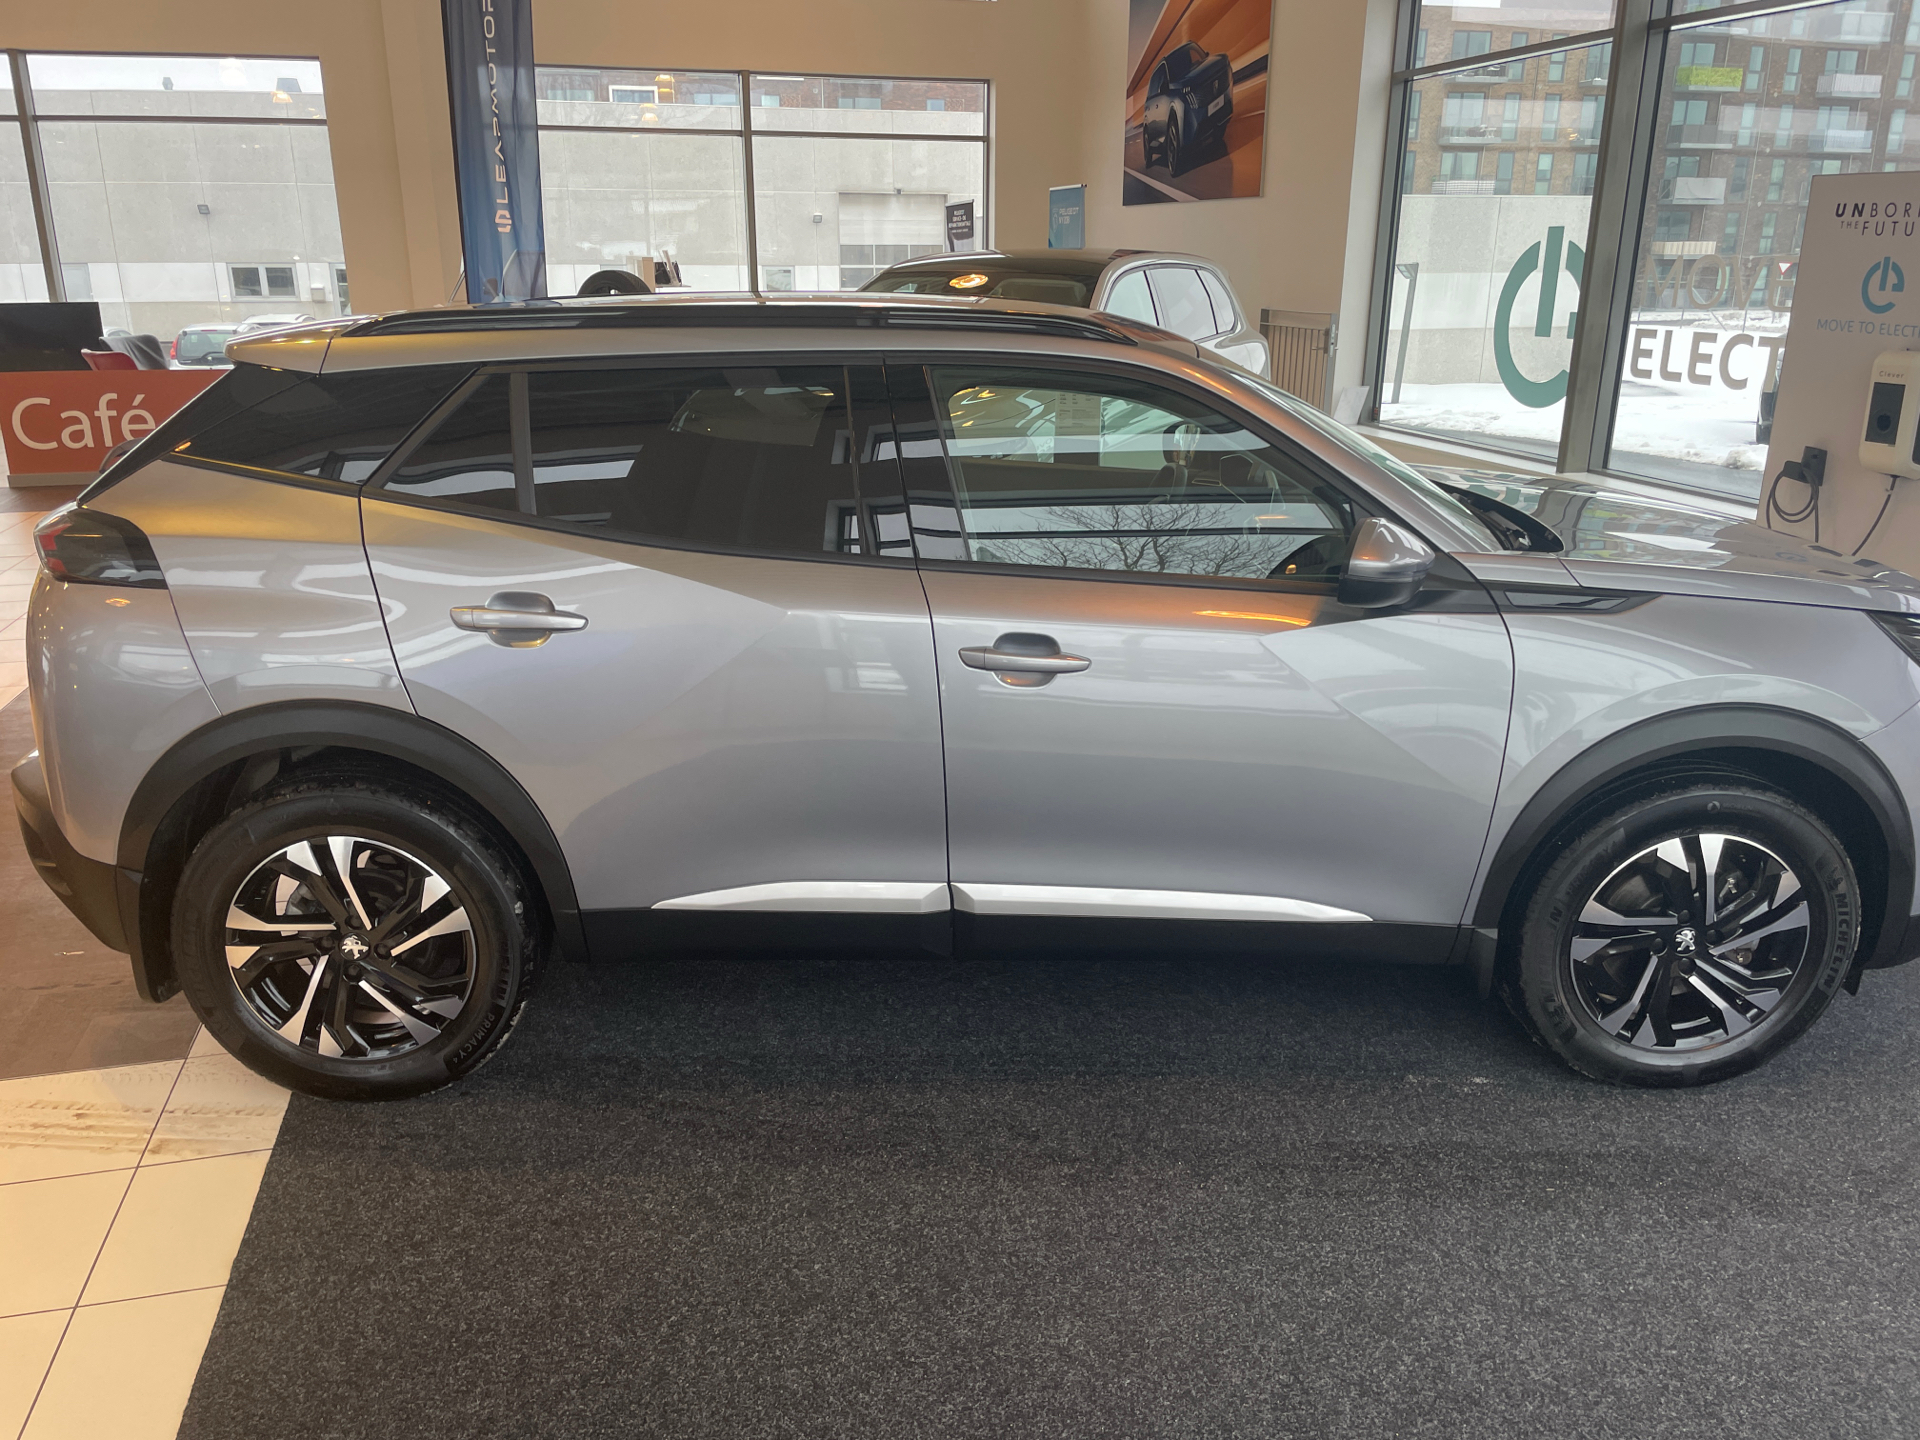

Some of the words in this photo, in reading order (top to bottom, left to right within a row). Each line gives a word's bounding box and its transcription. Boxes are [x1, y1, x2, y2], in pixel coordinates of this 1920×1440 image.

[1840, 220, 1859, 230] THE
[1640, 254, 1800, 313] MOVE
[1816, 318, 1855, 333] MOVE
[1858, 321, 1876, 335] TO
[1879, 323, 1920, 339] ELECT
[1630, 328, 1786, 393] ELECT
[1879, 370, 1905, 379] Clever
[11, 392, 156, 450] Café
[1823, 892, 1850, 990] MICHELIN
[458, 1012, 495, 1059] PRIMACY
